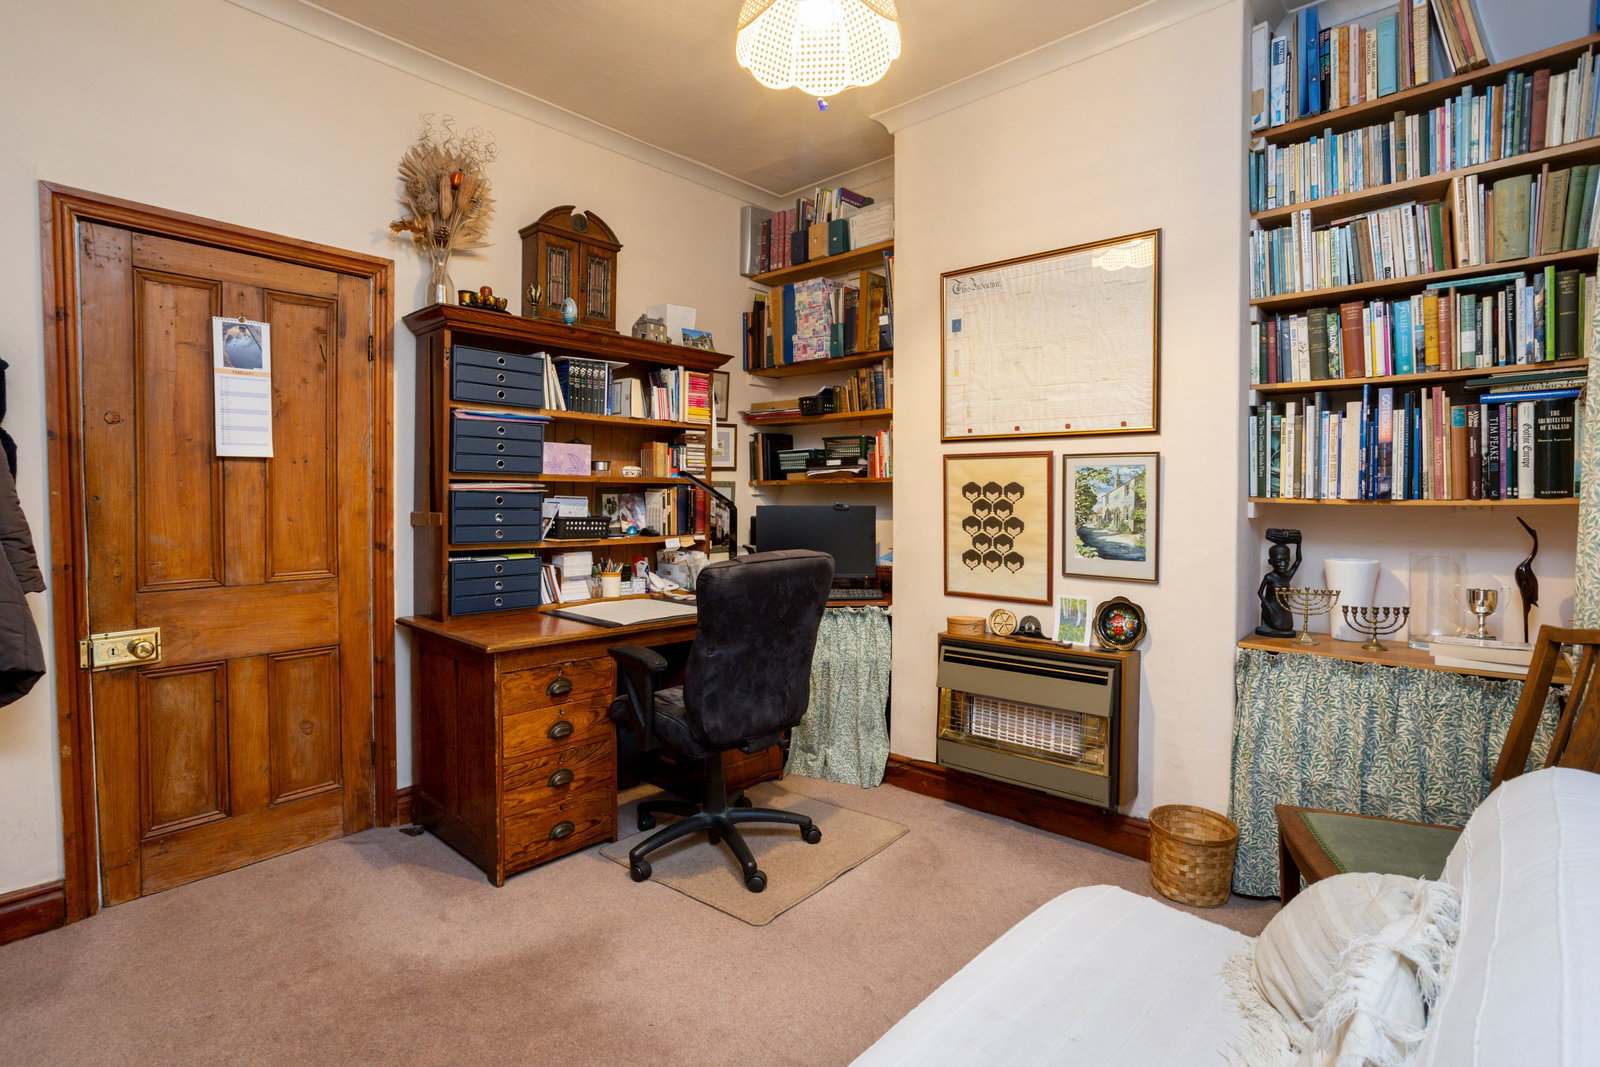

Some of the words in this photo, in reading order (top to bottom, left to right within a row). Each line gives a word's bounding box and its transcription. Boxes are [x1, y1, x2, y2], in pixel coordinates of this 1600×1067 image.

[1489, 416, 1499, 435] TIM
[1537, 416, 1573, 425] ARCHITECTURE
[1547, 423, 1570, 431] ENGLAND
[1522, 423, 1533, 445] Gothic
[1434, 436, 1442, 459] Albrecht
[1489, 436, 1499, 460] PEAKE
[1521, 445, 1532, 469] Europe
